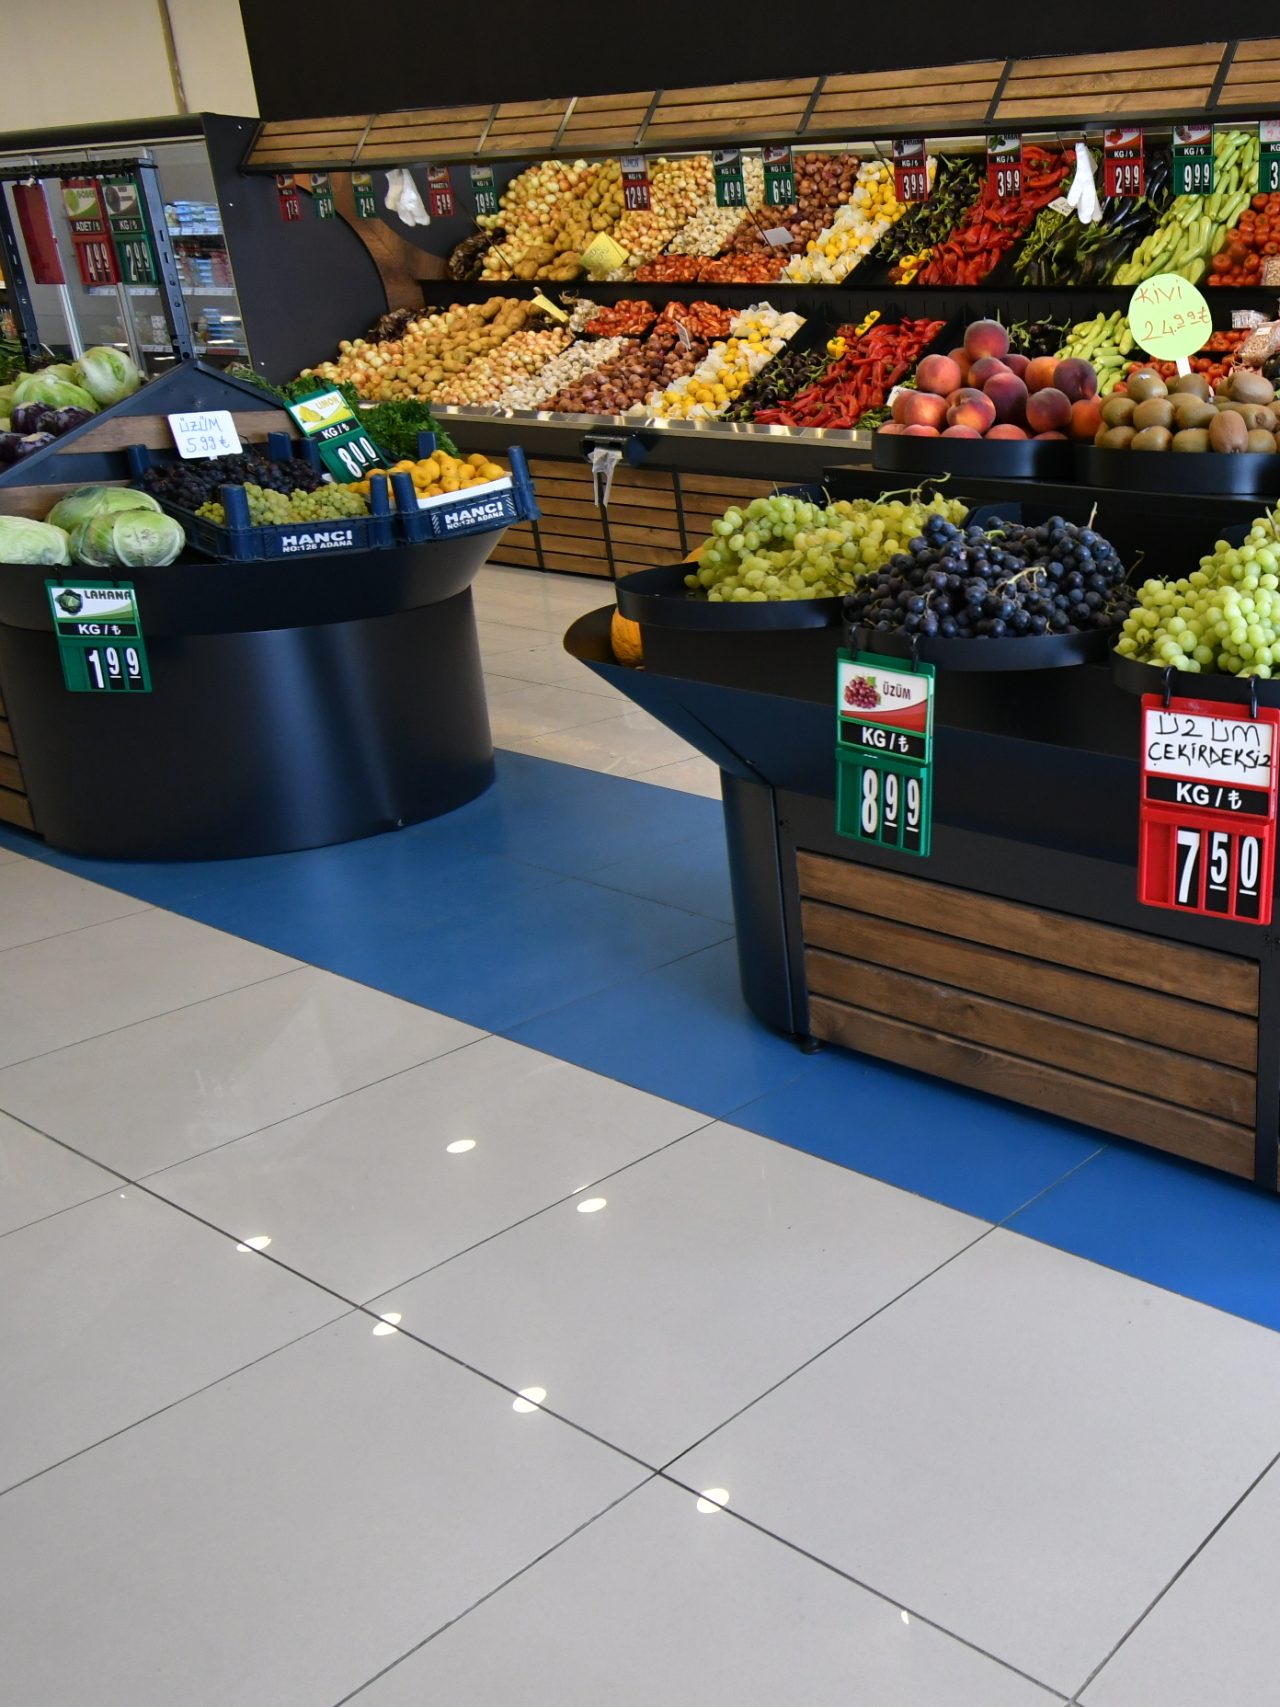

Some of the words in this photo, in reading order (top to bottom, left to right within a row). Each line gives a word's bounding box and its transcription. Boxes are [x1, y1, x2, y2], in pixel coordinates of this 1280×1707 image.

[320, 540, 353, 549] ADANA
[84, 590, 132, 600] LAHANA
[883, 681, 911, 700] ÜZÜM
